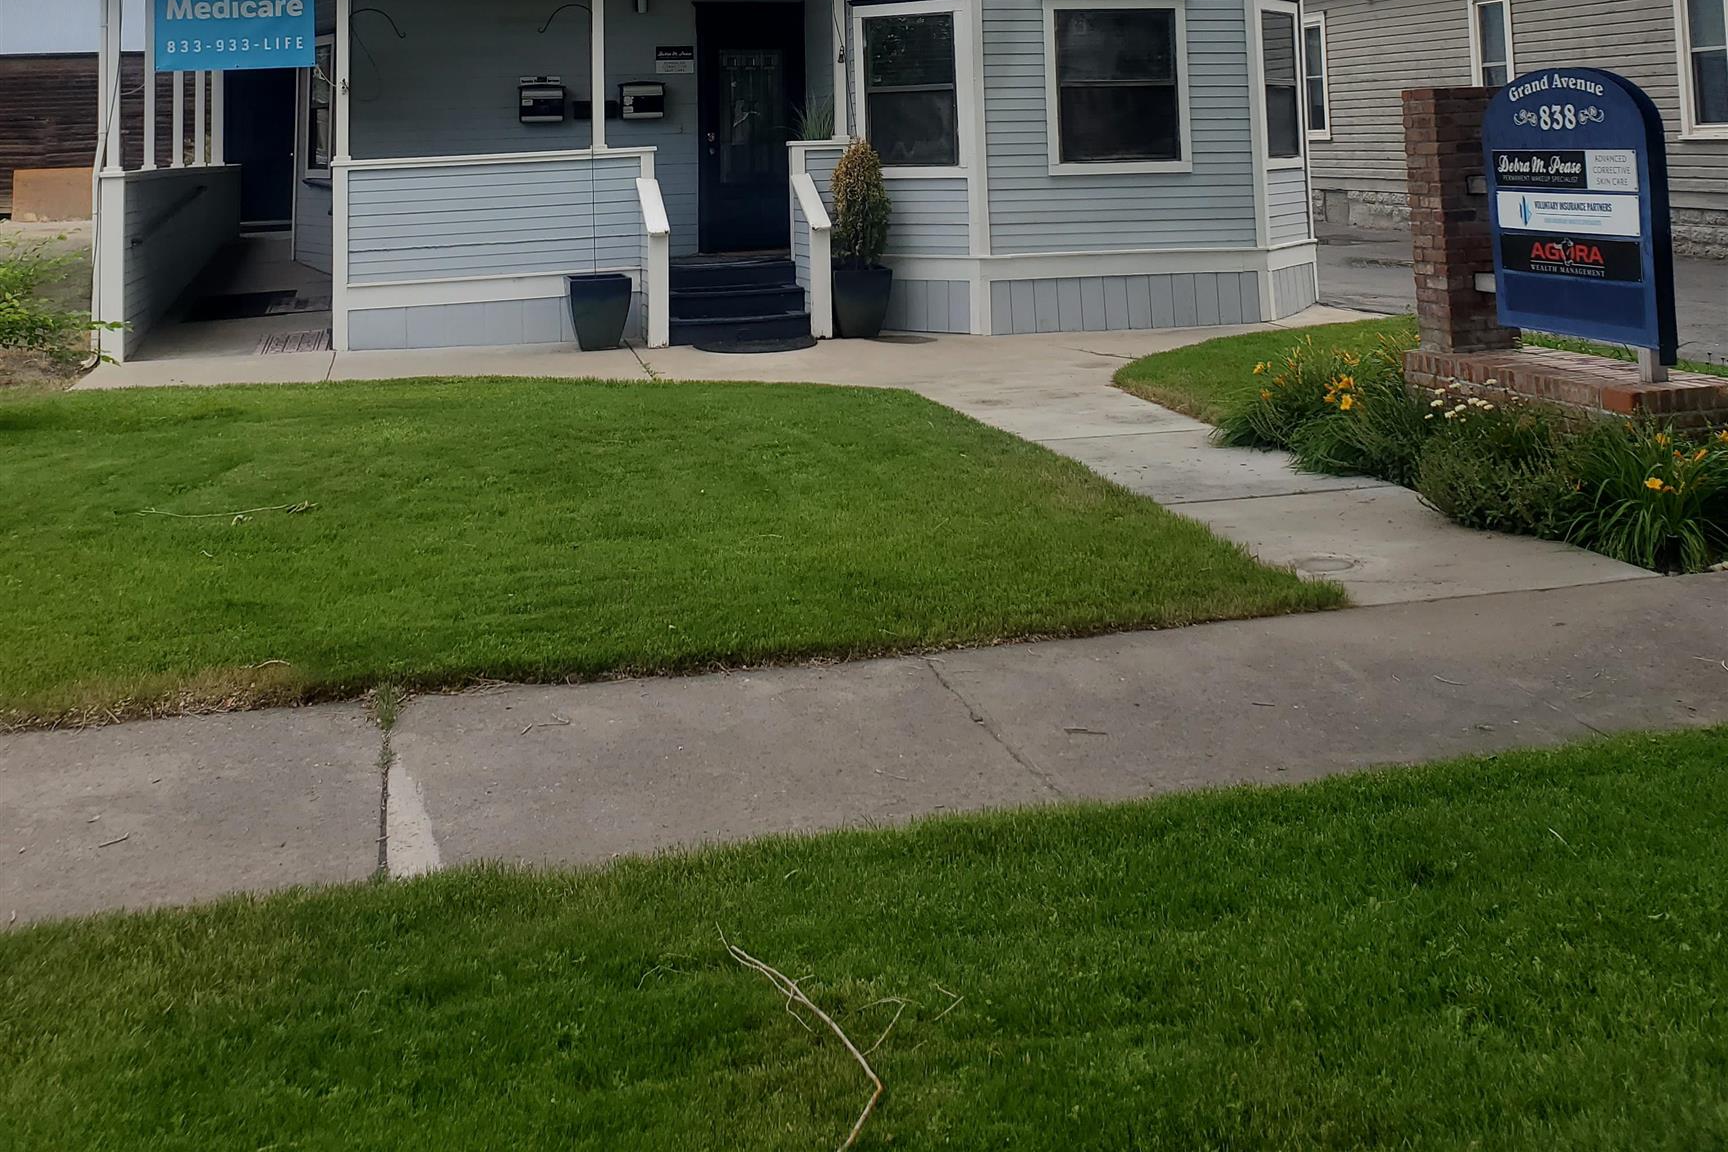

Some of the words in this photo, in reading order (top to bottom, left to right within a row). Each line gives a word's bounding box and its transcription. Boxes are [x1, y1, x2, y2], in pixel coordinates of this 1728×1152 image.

[166, 36, 304, 54] 833-933-LIFE
[1508, 75, 1549, 102] Grand
[1552, 73, 1604, 96] Avenue
[1539, 104, 1577, 130] 838
[1498, 154, 1530, 173] Debra
[1531, 156, 1547, 173] M.
[1548, 155, 1582, 174] Pease
[1594, 154, 1627, 164] ADVANCED
[1592, 166, 1631, 175] CORRECTIVE
[1596, 177, 1611, 185] SKIN
[1612, 177, 1628, 186] CARE
[1534, 200, 1559, 211] VOLUNTARY
[1559, 201, 1587, 212] INSURANCE
[1587, 202, 1612, 213] PARTNERS
[1530, 264, 1558, 273] WEALTH
[1560, 266, 1605, 278] MANAGEMENT
